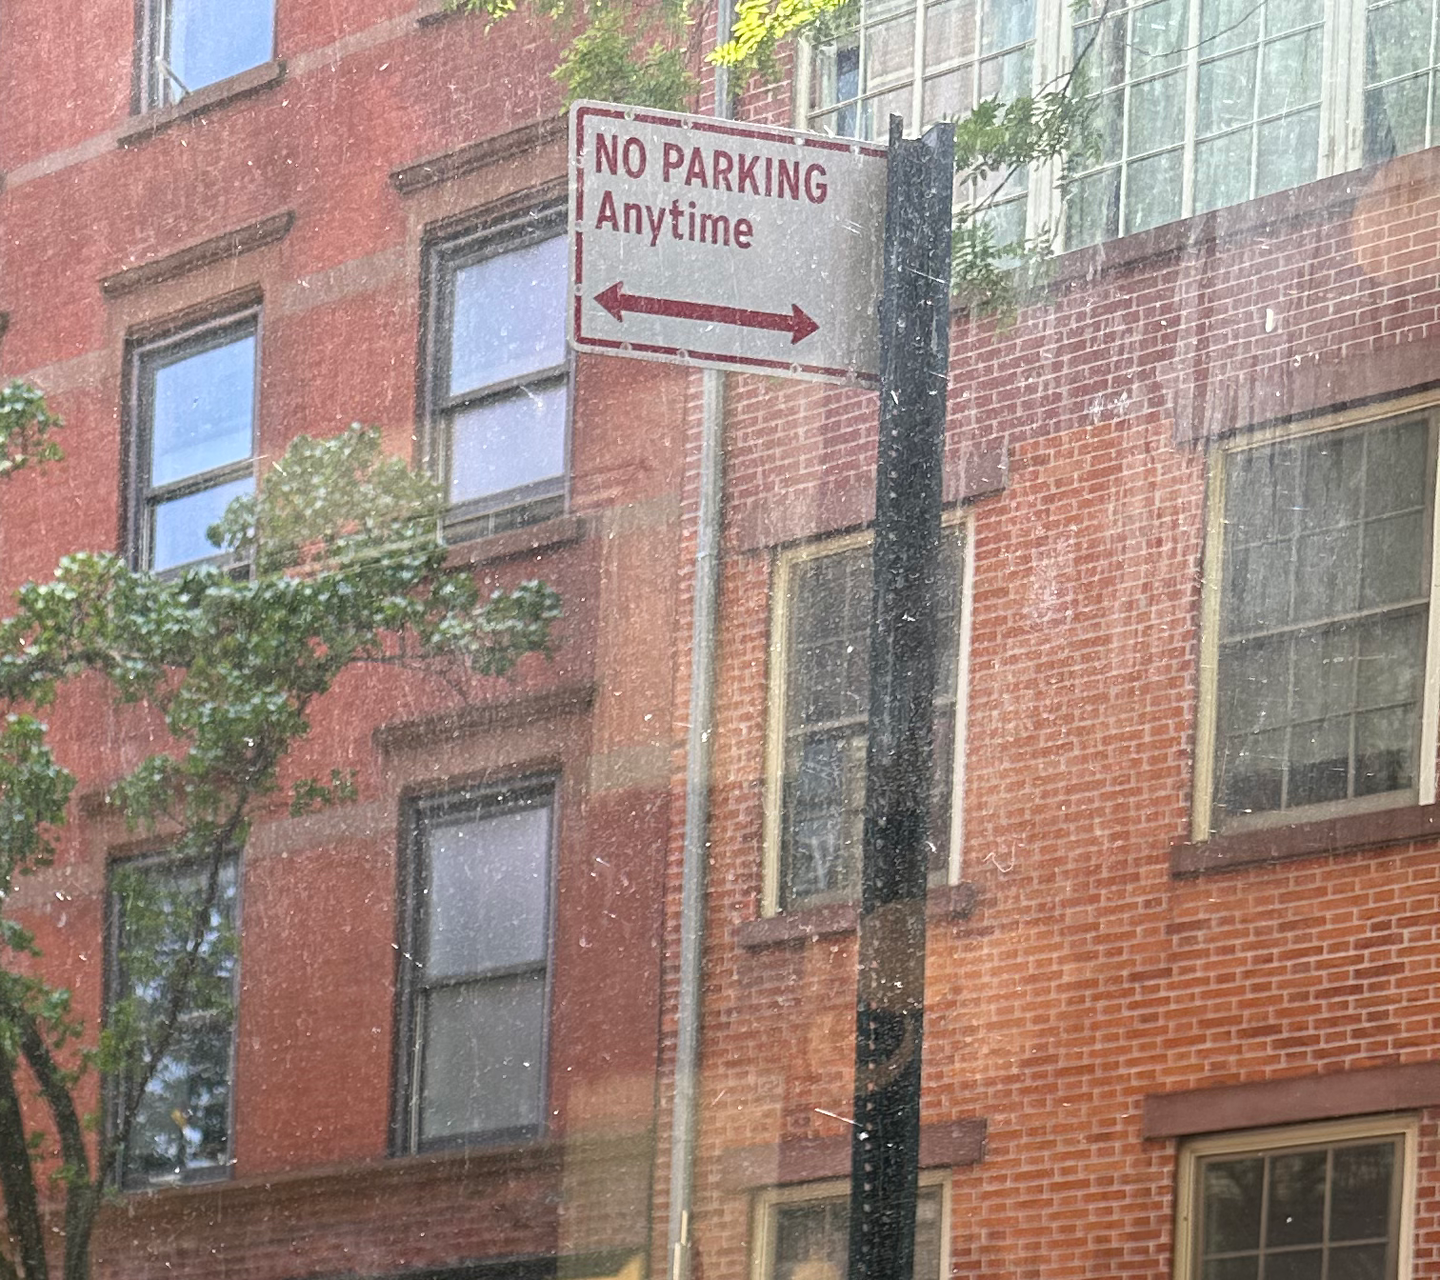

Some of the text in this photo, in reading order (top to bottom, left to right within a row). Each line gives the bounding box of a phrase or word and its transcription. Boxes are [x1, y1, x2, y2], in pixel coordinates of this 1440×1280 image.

[595, 133, 828, 204] NO PARKING
[595, 190, 754, 249] Anytime
